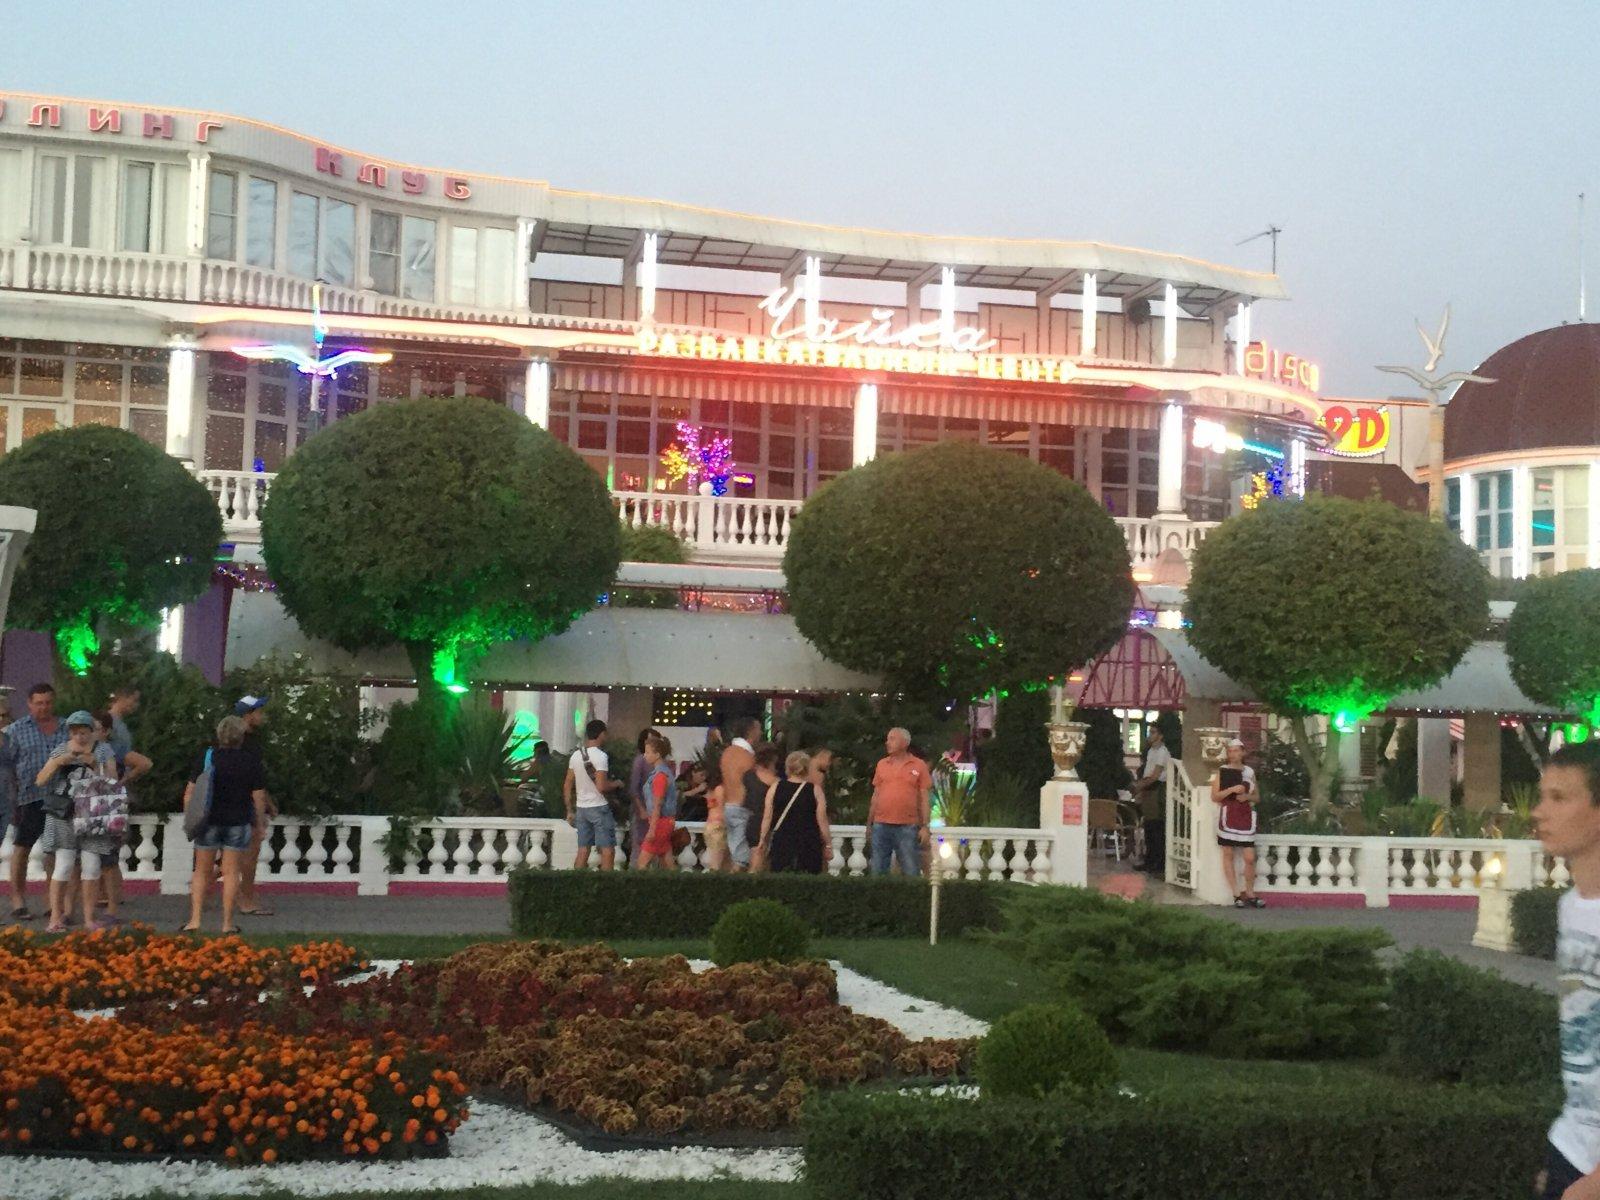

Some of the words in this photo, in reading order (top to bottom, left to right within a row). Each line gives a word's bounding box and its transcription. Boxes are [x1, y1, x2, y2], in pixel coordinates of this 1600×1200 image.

[0, 99, 223, 142] ЛИНГ
[315, 147, 472, 200] КЛУБ
[757, 287, 998, 352] Чайка
[1325, 406, 1385, 448] 9D
